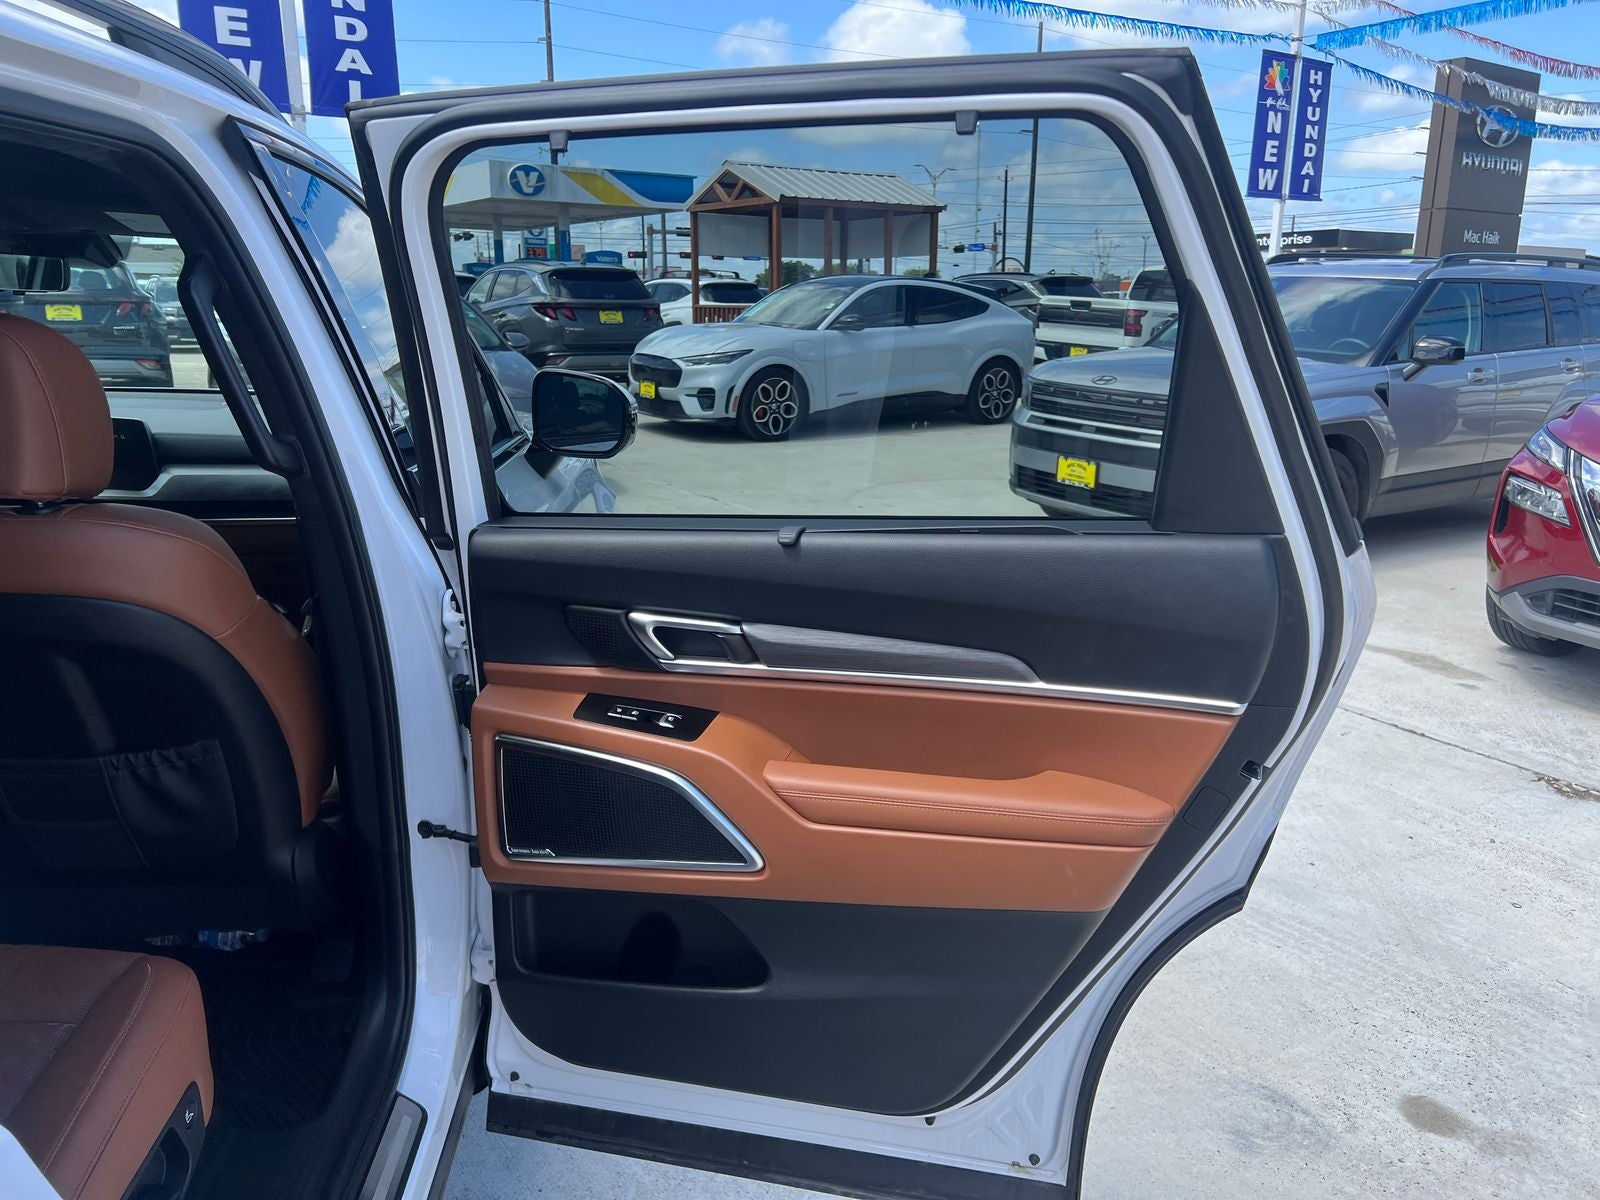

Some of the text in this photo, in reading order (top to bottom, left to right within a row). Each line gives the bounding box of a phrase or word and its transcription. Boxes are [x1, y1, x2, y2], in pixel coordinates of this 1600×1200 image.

[1258, 111, 1282, 191] NEW
[1300, 69, 1323, 193] HYUNDAI
[1462, 152, 1523, 176] HYUNDAI
[1463, 229, 1500, 245] Mac Haik
